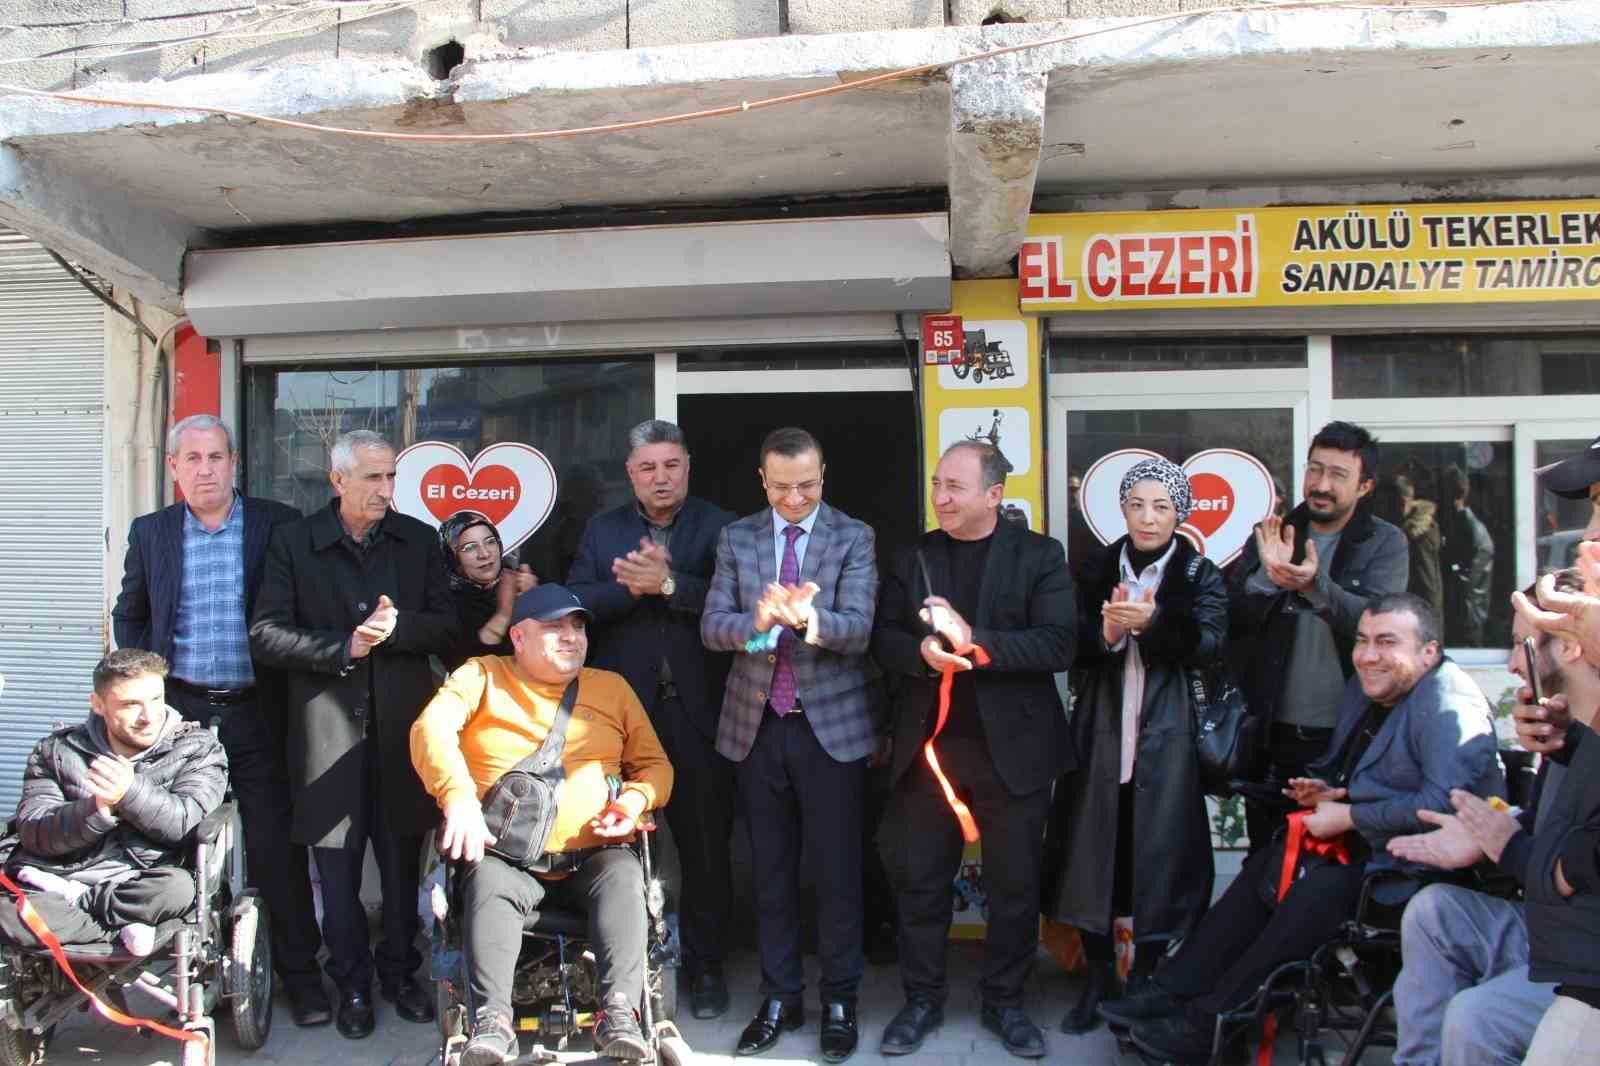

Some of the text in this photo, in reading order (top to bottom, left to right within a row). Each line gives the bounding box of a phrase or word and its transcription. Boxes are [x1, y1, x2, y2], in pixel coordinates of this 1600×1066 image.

[1294, 211, 1600, 250] AKÜLÜ TEKERLEK
[1020, 219, 1252, 298] EL CEZERİ
[1282, 250, 1600, 293] SANDALYE TAMİRC
[933, 330, 953, 347] 65
[452, 485, 515, 500] Cezeri
[1190, 495, 1228, 511] zeri
